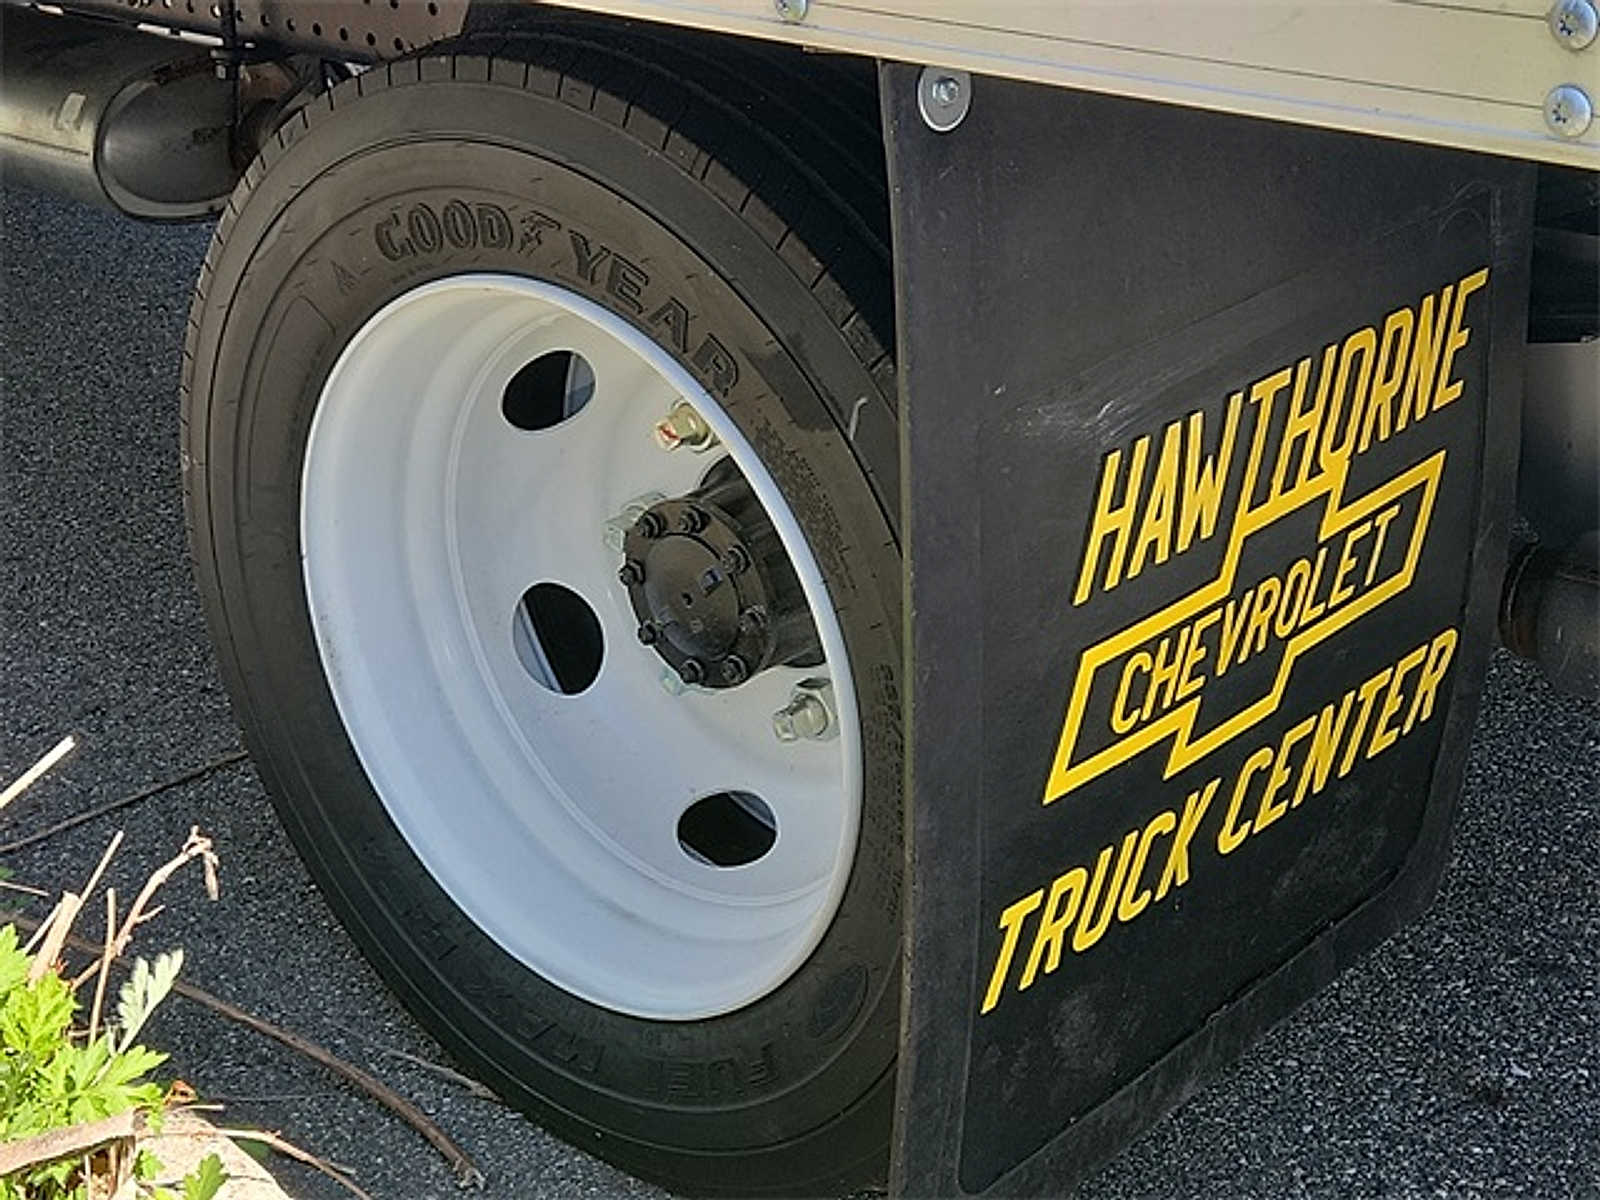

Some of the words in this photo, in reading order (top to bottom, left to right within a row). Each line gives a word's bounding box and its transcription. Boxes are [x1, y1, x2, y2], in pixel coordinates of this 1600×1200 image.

[1073, 266, 1490, 606] HAWTHORNE
[1110, 504, 1401, 734] CHEVROLET
[981, 778, 1221, 1014] TRUCK
[1216, 628, 1459, 855] CENTER
